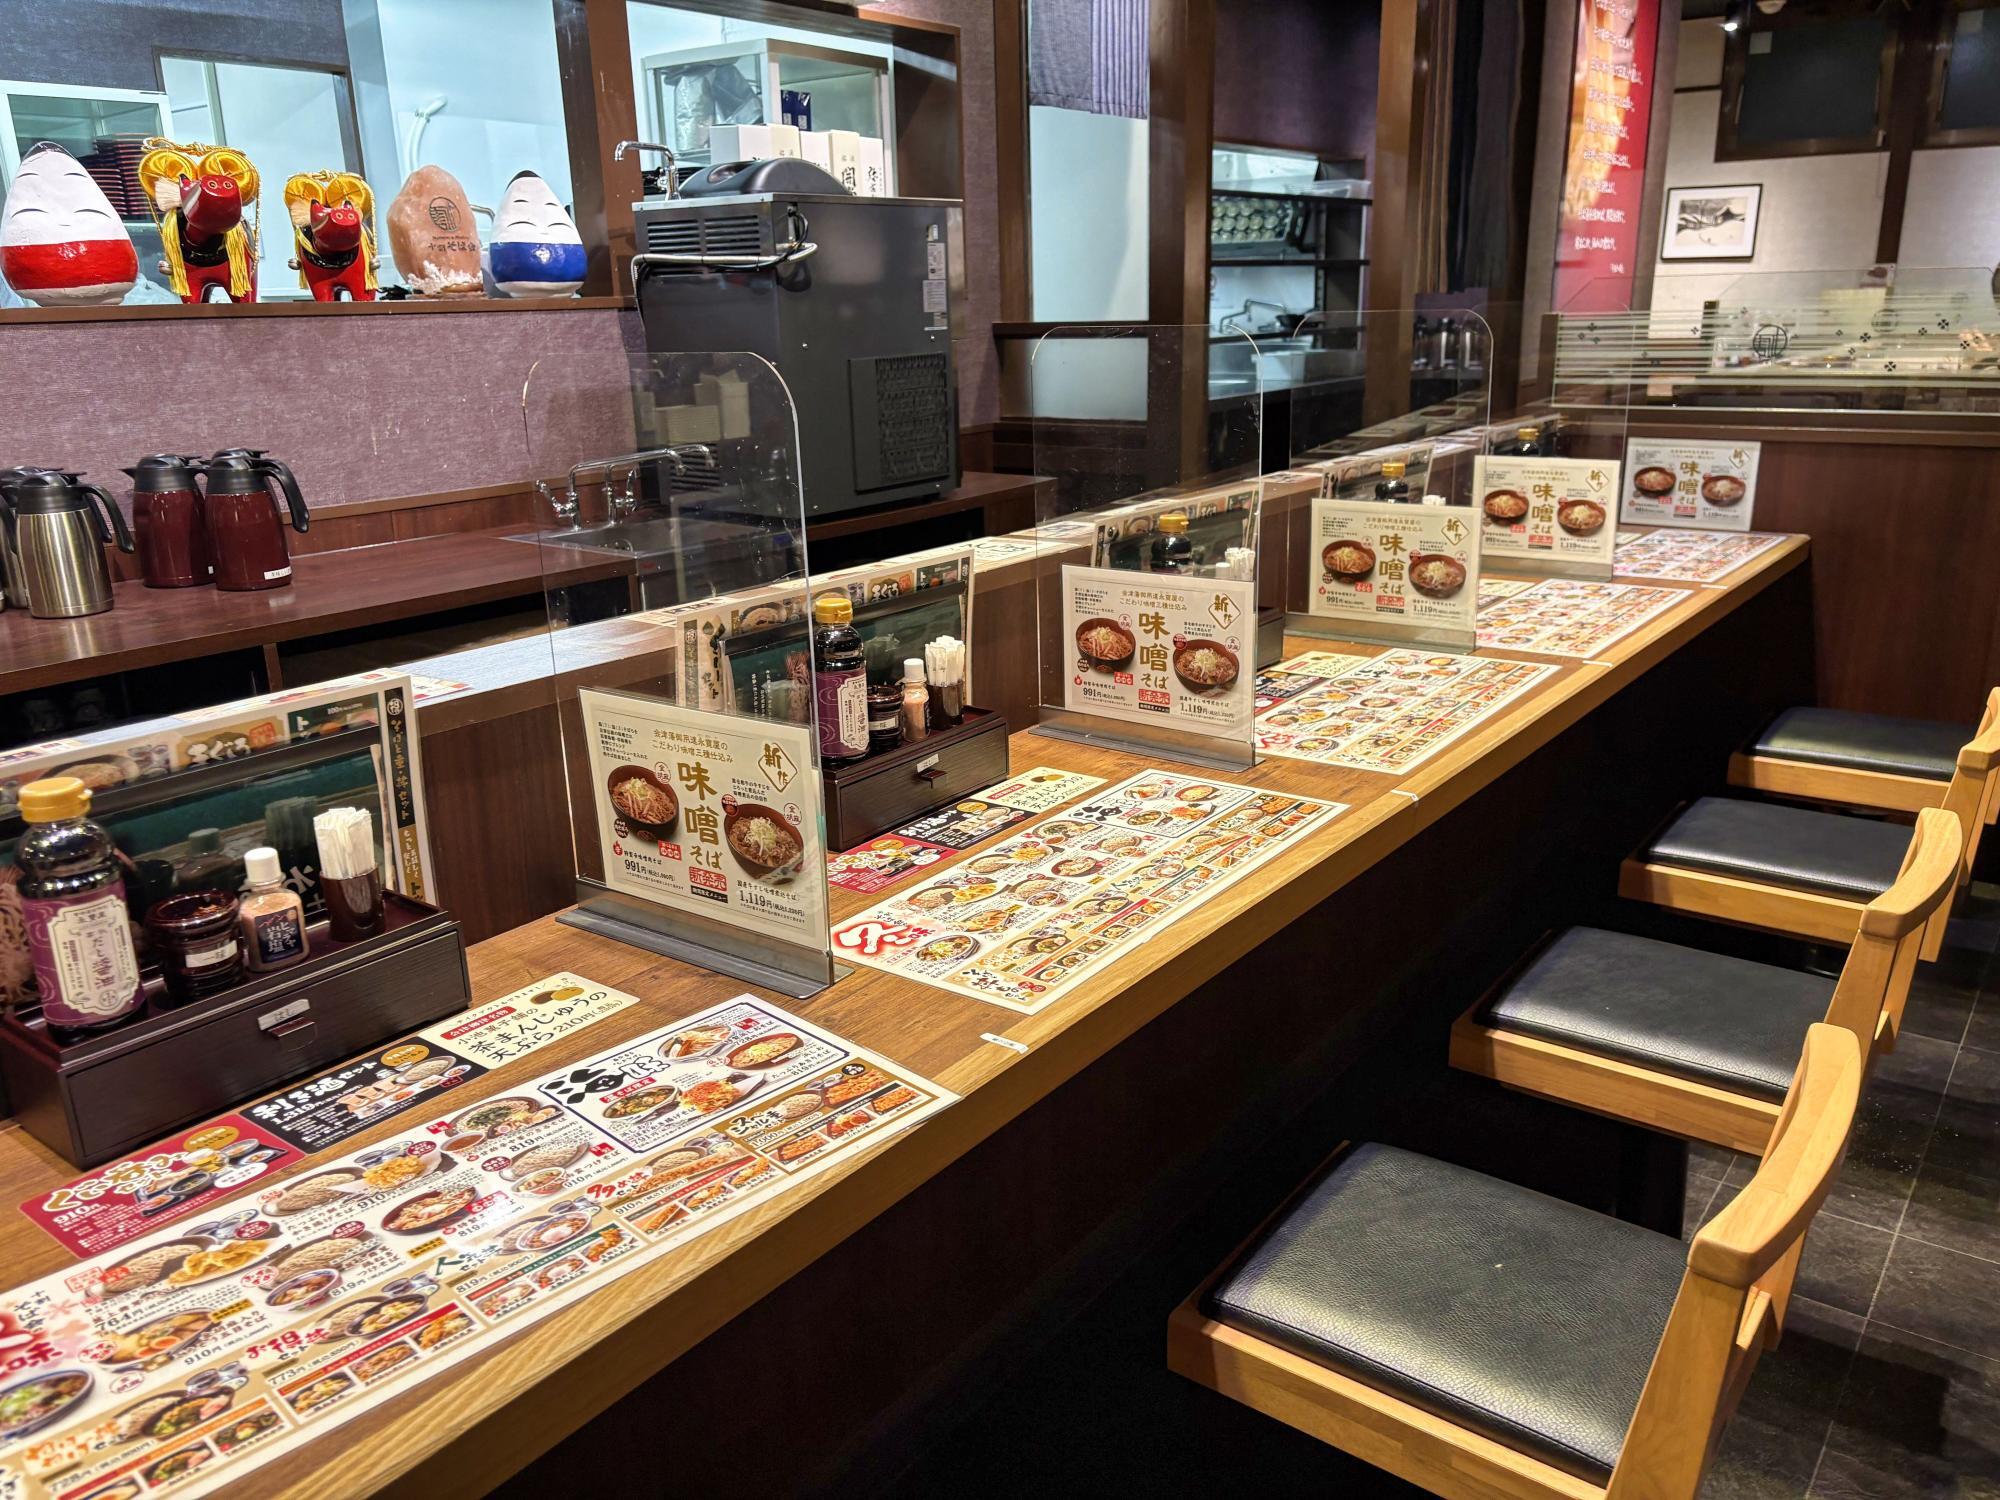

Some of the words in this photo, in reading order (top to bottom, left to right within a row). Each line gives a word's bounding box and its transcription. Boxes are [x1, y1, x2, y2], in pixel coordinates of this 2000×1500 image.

[1678, 461, 1702, 496] 味噌
[1532, 482, 1556, 523] 味噌
[1531, 524, 1552, 535] そば
[1379, 533, 1407, 581] 味噌
[1379, 582, 1404, 595] そば
[762, 741, 790, 786] 新作
[677, 761, 719, 846] 味噌
[623, 858, 646, 874] 991円
[688, 844, 722, 871] そば
[738, 889, 772, 909] 1,119円
[266, 926, 285, 953] 岩塩
[454, 1007, 541, 1045] 小池菓子舗の
[465, 990, 610, 1054] 茶まんじゅうの
[484, 1029, 556, 1062] 天ぷら
[551, 1012, 596, 1032] 210円
[247, 1060, 380, 1119] 利き酒セット
[506, 1134, 546, 1152] 819円
[51, 1201, 101, 1224] 910円
[288, 1206, 357, 1236] かき揚げそば
[354, 1189, 398, 1209] 910円
[612, 1198, 646, 1215] 910円
[354, 1254, 403, 1277] つけそば
[328, 1277, 368, 1297] 819円
[453, 1275, 490, 1293] 819円
[93, 1307, 146, 1331] 764円
[181, 1343, 224, 1365] 910円
[246, 1325, 335, 1360] お得丼
[266, 1364, 308, 1385] 773円
[45, 1467, 95, 1493] 728円
